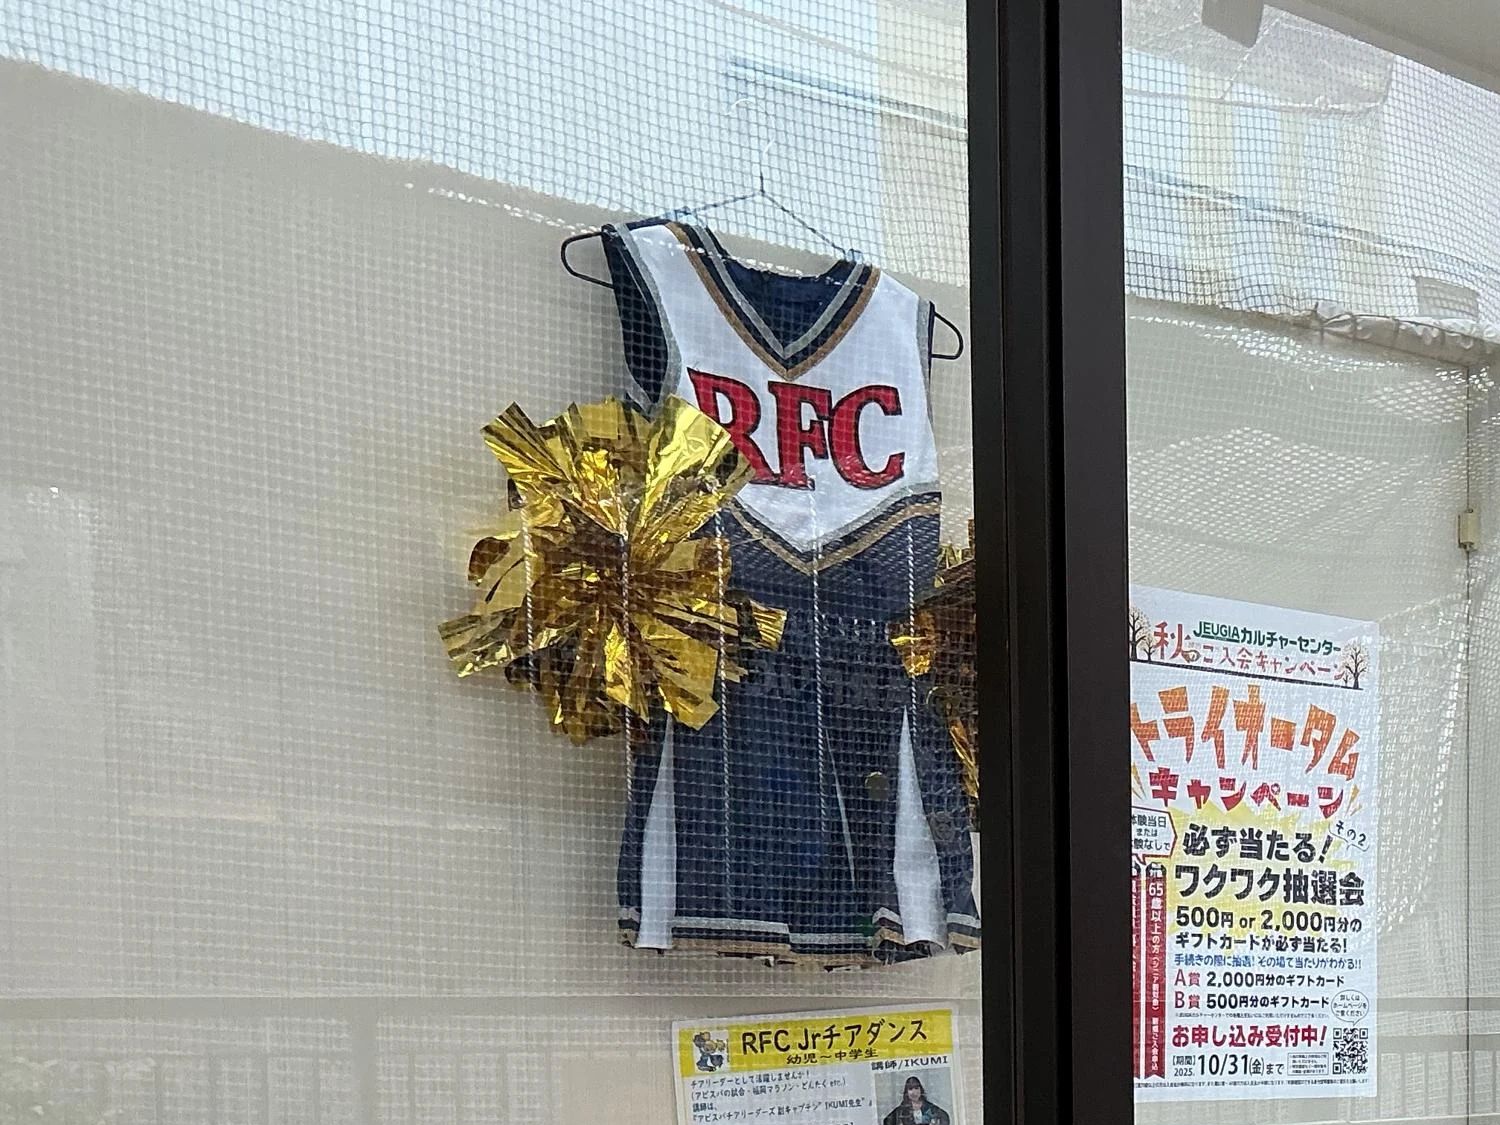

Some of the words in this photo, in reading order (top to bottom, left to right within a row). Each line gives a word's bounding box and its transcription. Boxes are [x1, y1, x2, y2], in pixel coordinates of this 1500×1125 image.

[687, 367, 905, 490] RFC
[1193, 621, 1341, 655] JEUGIAカルチャーセンター
[1149, 766, 1344, 819] キャンペーン
[1136, 828, 1158, 837] または
[1335, 820, 1368, 846] その2
[1174, 863, 1365, 906] ワクワク抽選会
[1176, 906, 1234, 928] 500円
[1240, 917, 1256, 929] or
[1260, 910, 1362, 933] 2,000円分の
[1174, 970, 1201, 987] A賞
[1206, 971, 1345, 988] 2,000円分のギフトカード
[1174, 991, 1201, 1009] B賞
[1206, 993, 1330, 1010] 500円分のギフトカード
[742, 1029, 790, 1055] RFC
[797, 1018, 928, 1049] Jrチアダンス
